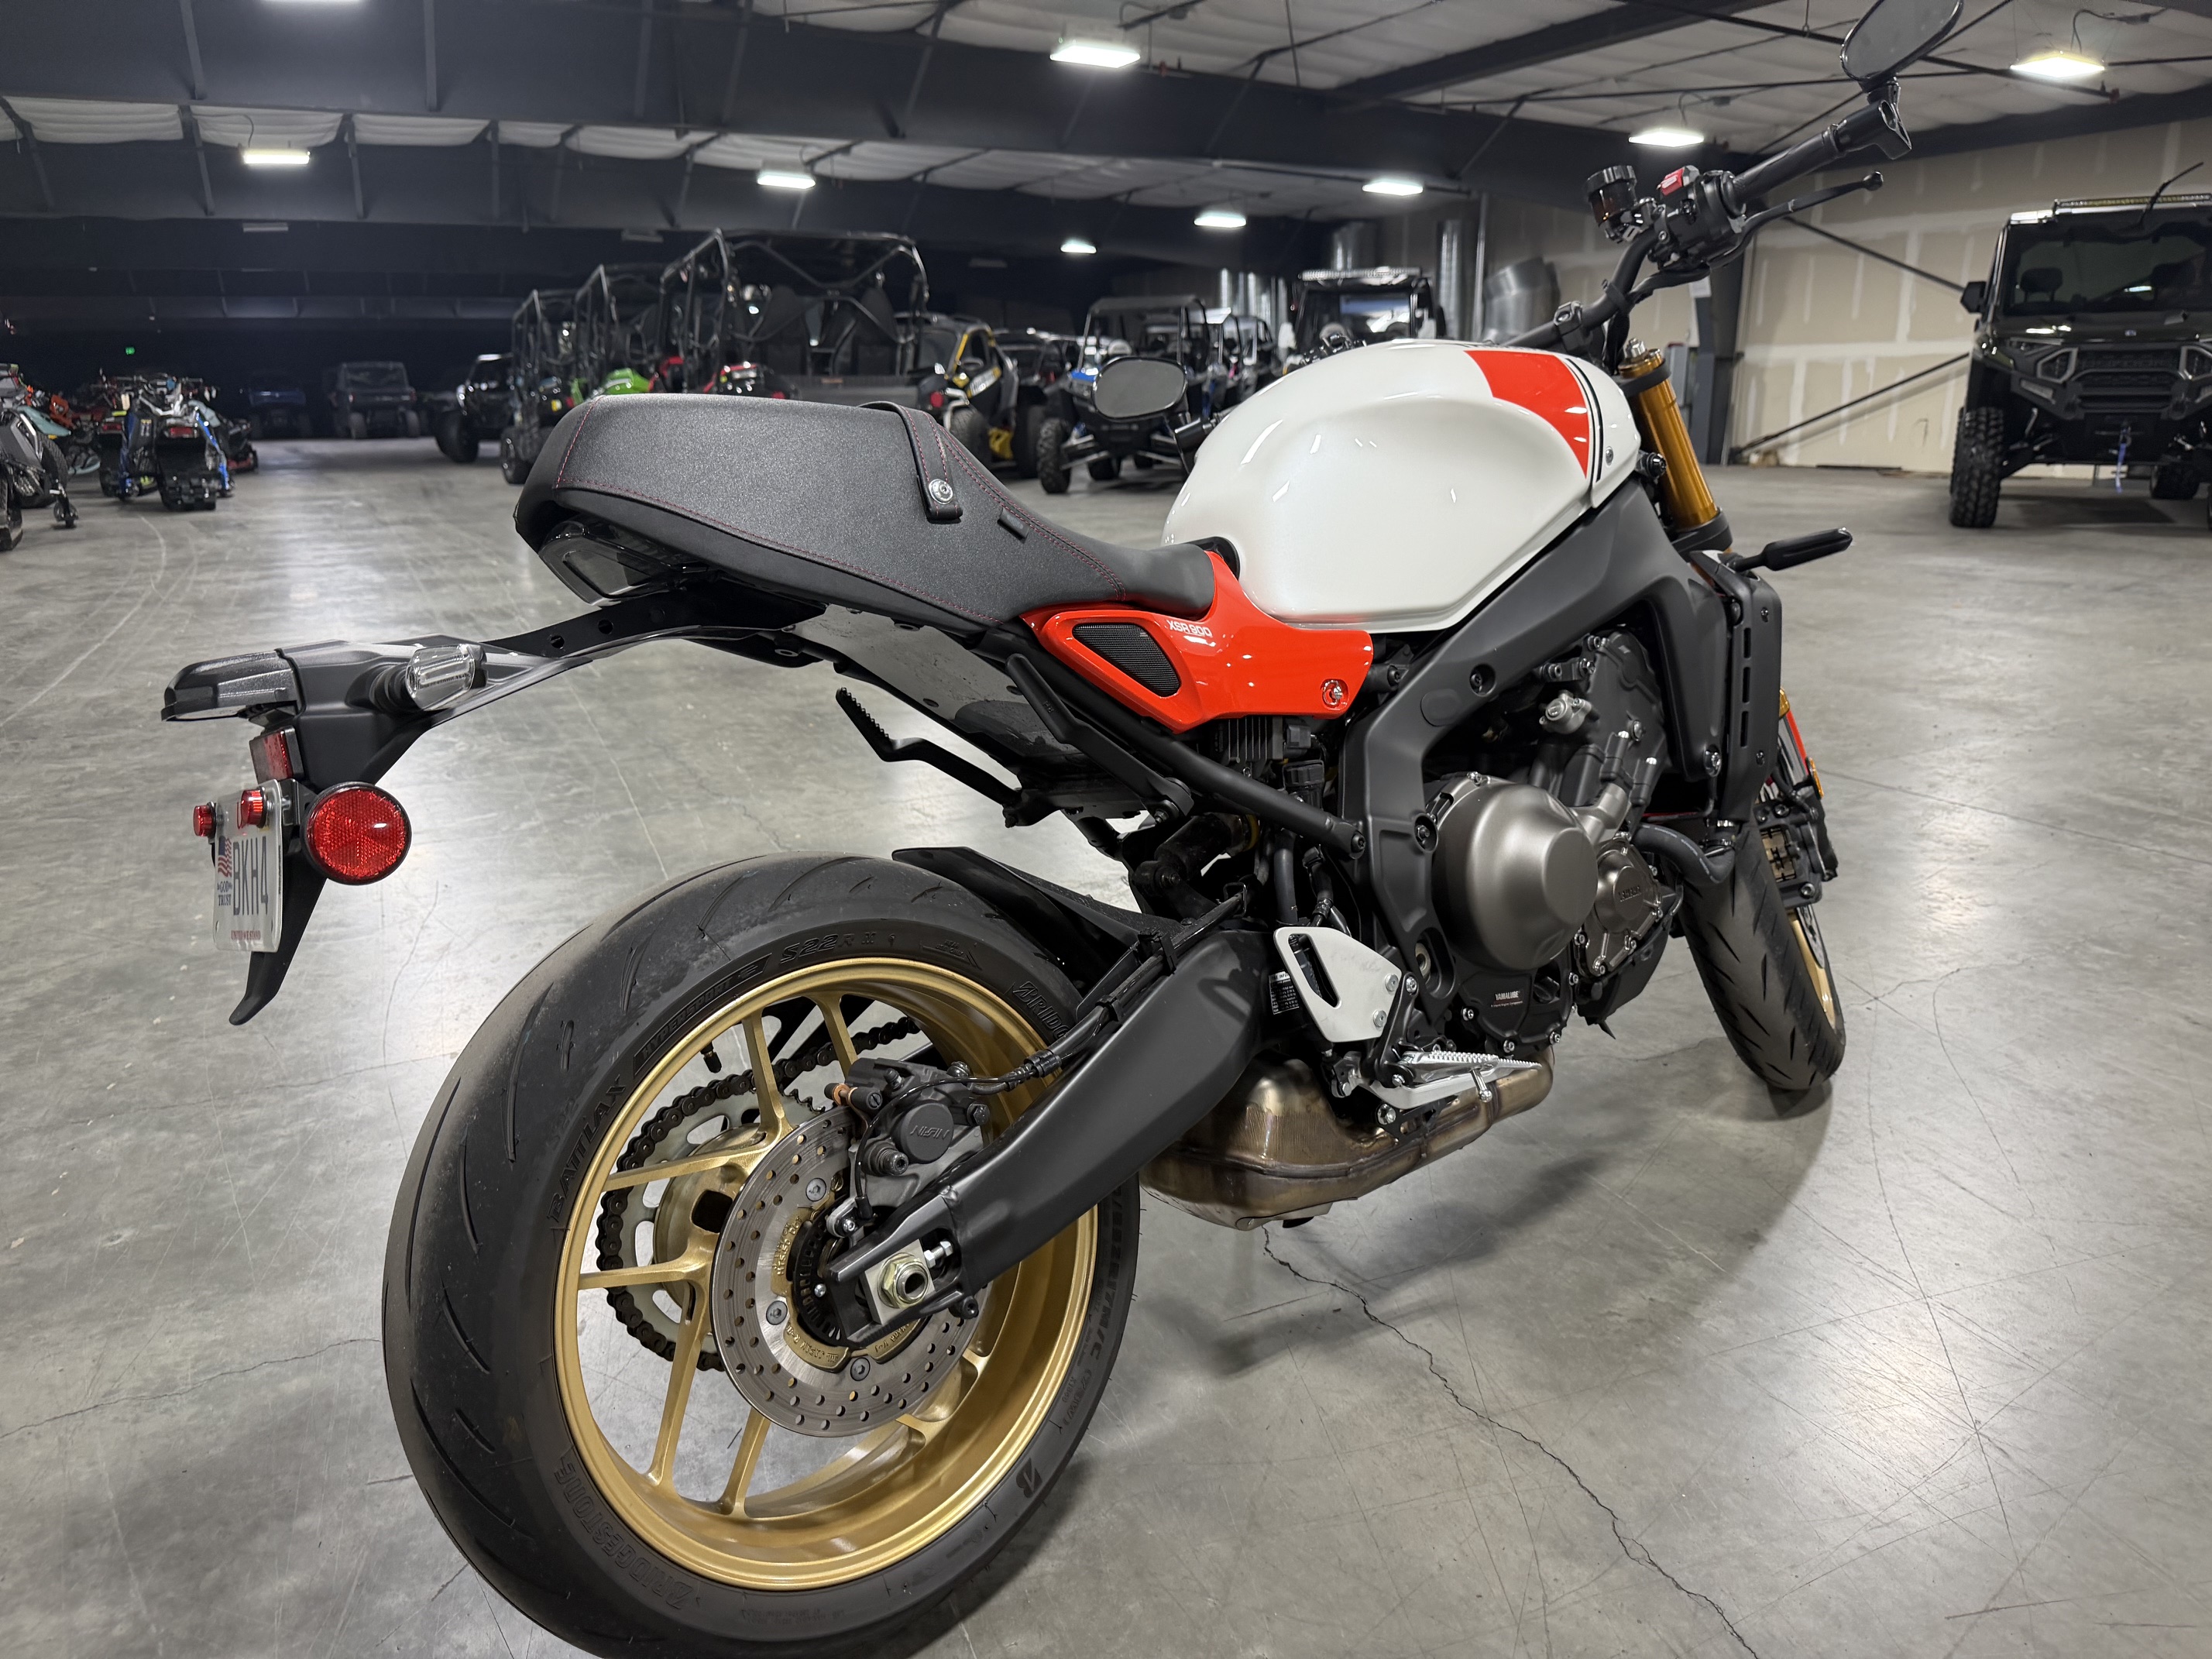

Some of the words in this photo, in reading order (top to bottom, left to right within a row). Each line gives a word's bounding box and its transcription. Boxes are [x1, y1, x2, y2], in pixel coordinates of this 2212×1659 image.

[1166, 620, 1213, 637] XSR900
[218, 894, 232, 906] TRUST
[232, 835, 269, 916] BKH4
[641, 977, 732, 1060] HYPERSPORT
[1495, 991, 1519, 1001] YAMALUBE
[546, 1074, 627, 1222] BATTLAX
[554, 1458, 694, 1610] BRIDGESTONE
